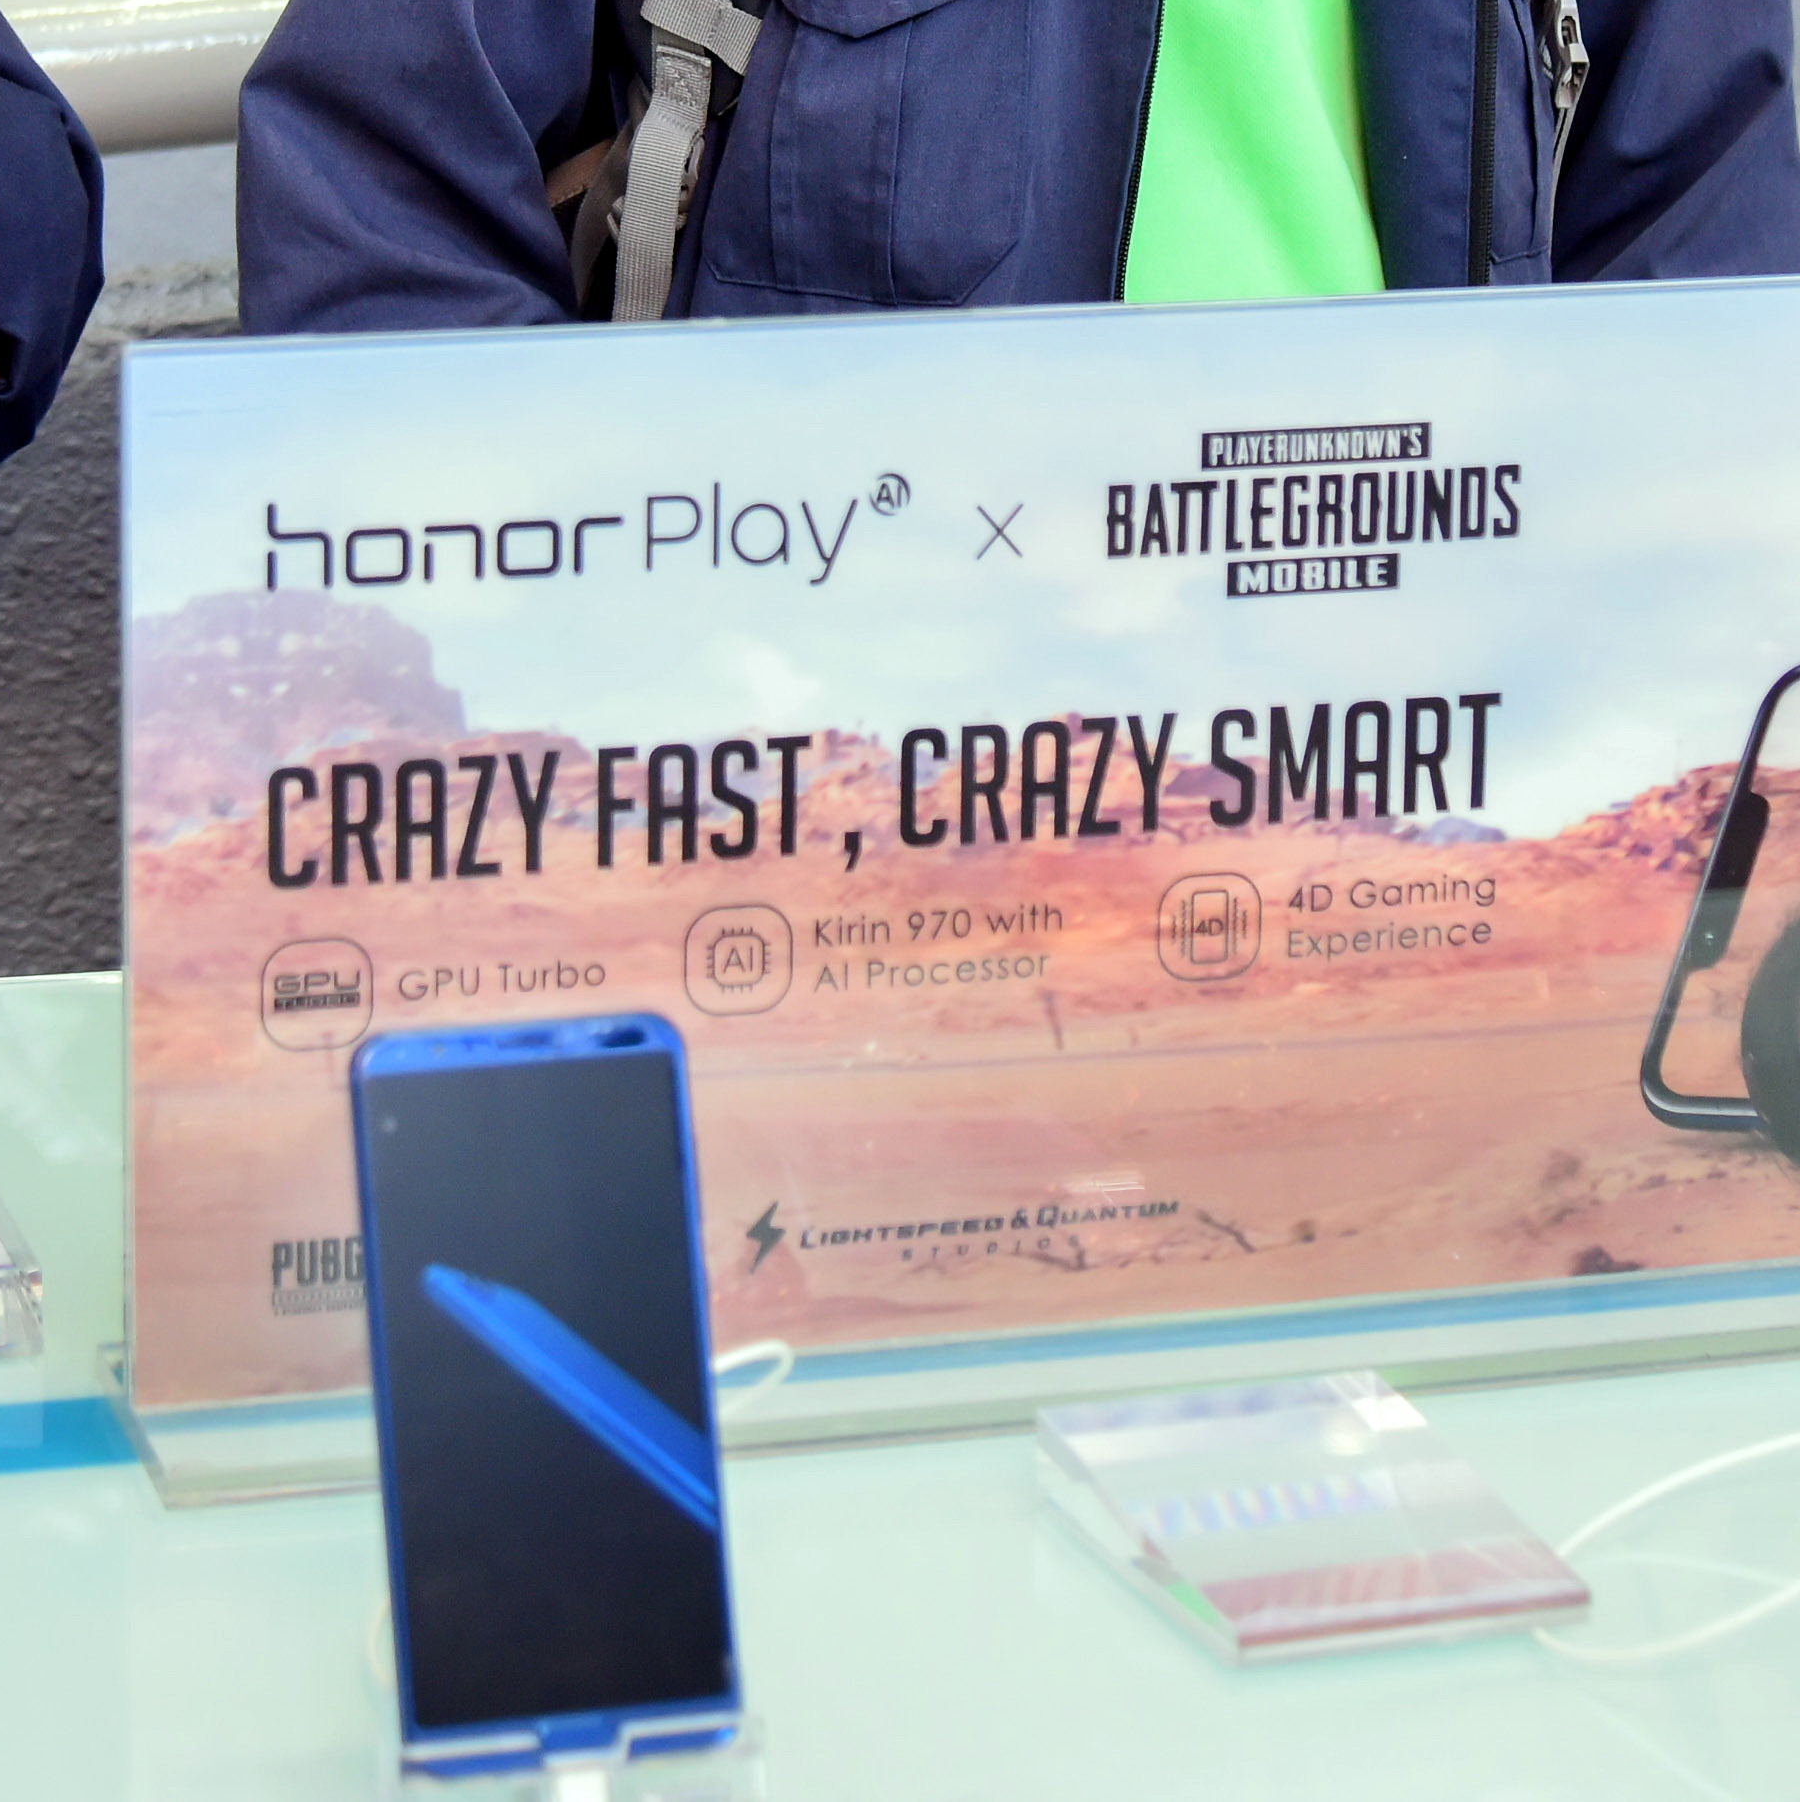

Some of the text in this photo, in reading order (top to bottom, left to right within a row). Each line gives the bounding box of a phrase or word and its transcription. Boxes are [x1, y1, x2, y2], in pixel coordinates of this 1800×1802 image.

[1208, 427, 1423, 466] PLAYERUNKNOWN'S
[1106, 464, 1521, 558] BATTLEGROUNDS
[267, 501, 624, 592] honor
[645, 481, 858, 585] Play
[1235, 558, 1390, 595] MOBILE
[267, 750, 560, 888] CRAZY
[900, 712, 1177, 848] CRAZY
[1210, 692, 1502, 829] SMART
[1288, 873, 1497, 914] 4D Gaming
[814, 904, 1063, 948] Kirin 970 with
[1287, 921, 1493, 961] Experience
[274, 969, 361, 996] GPU
[399, 961, 606, 1001] GPU Turbo
[813, 953, 1052, 993] AI Processor
[1037, 1200, 1179, 1229] QUANTUM
[273, 1237, 366, 1289] PUBG
